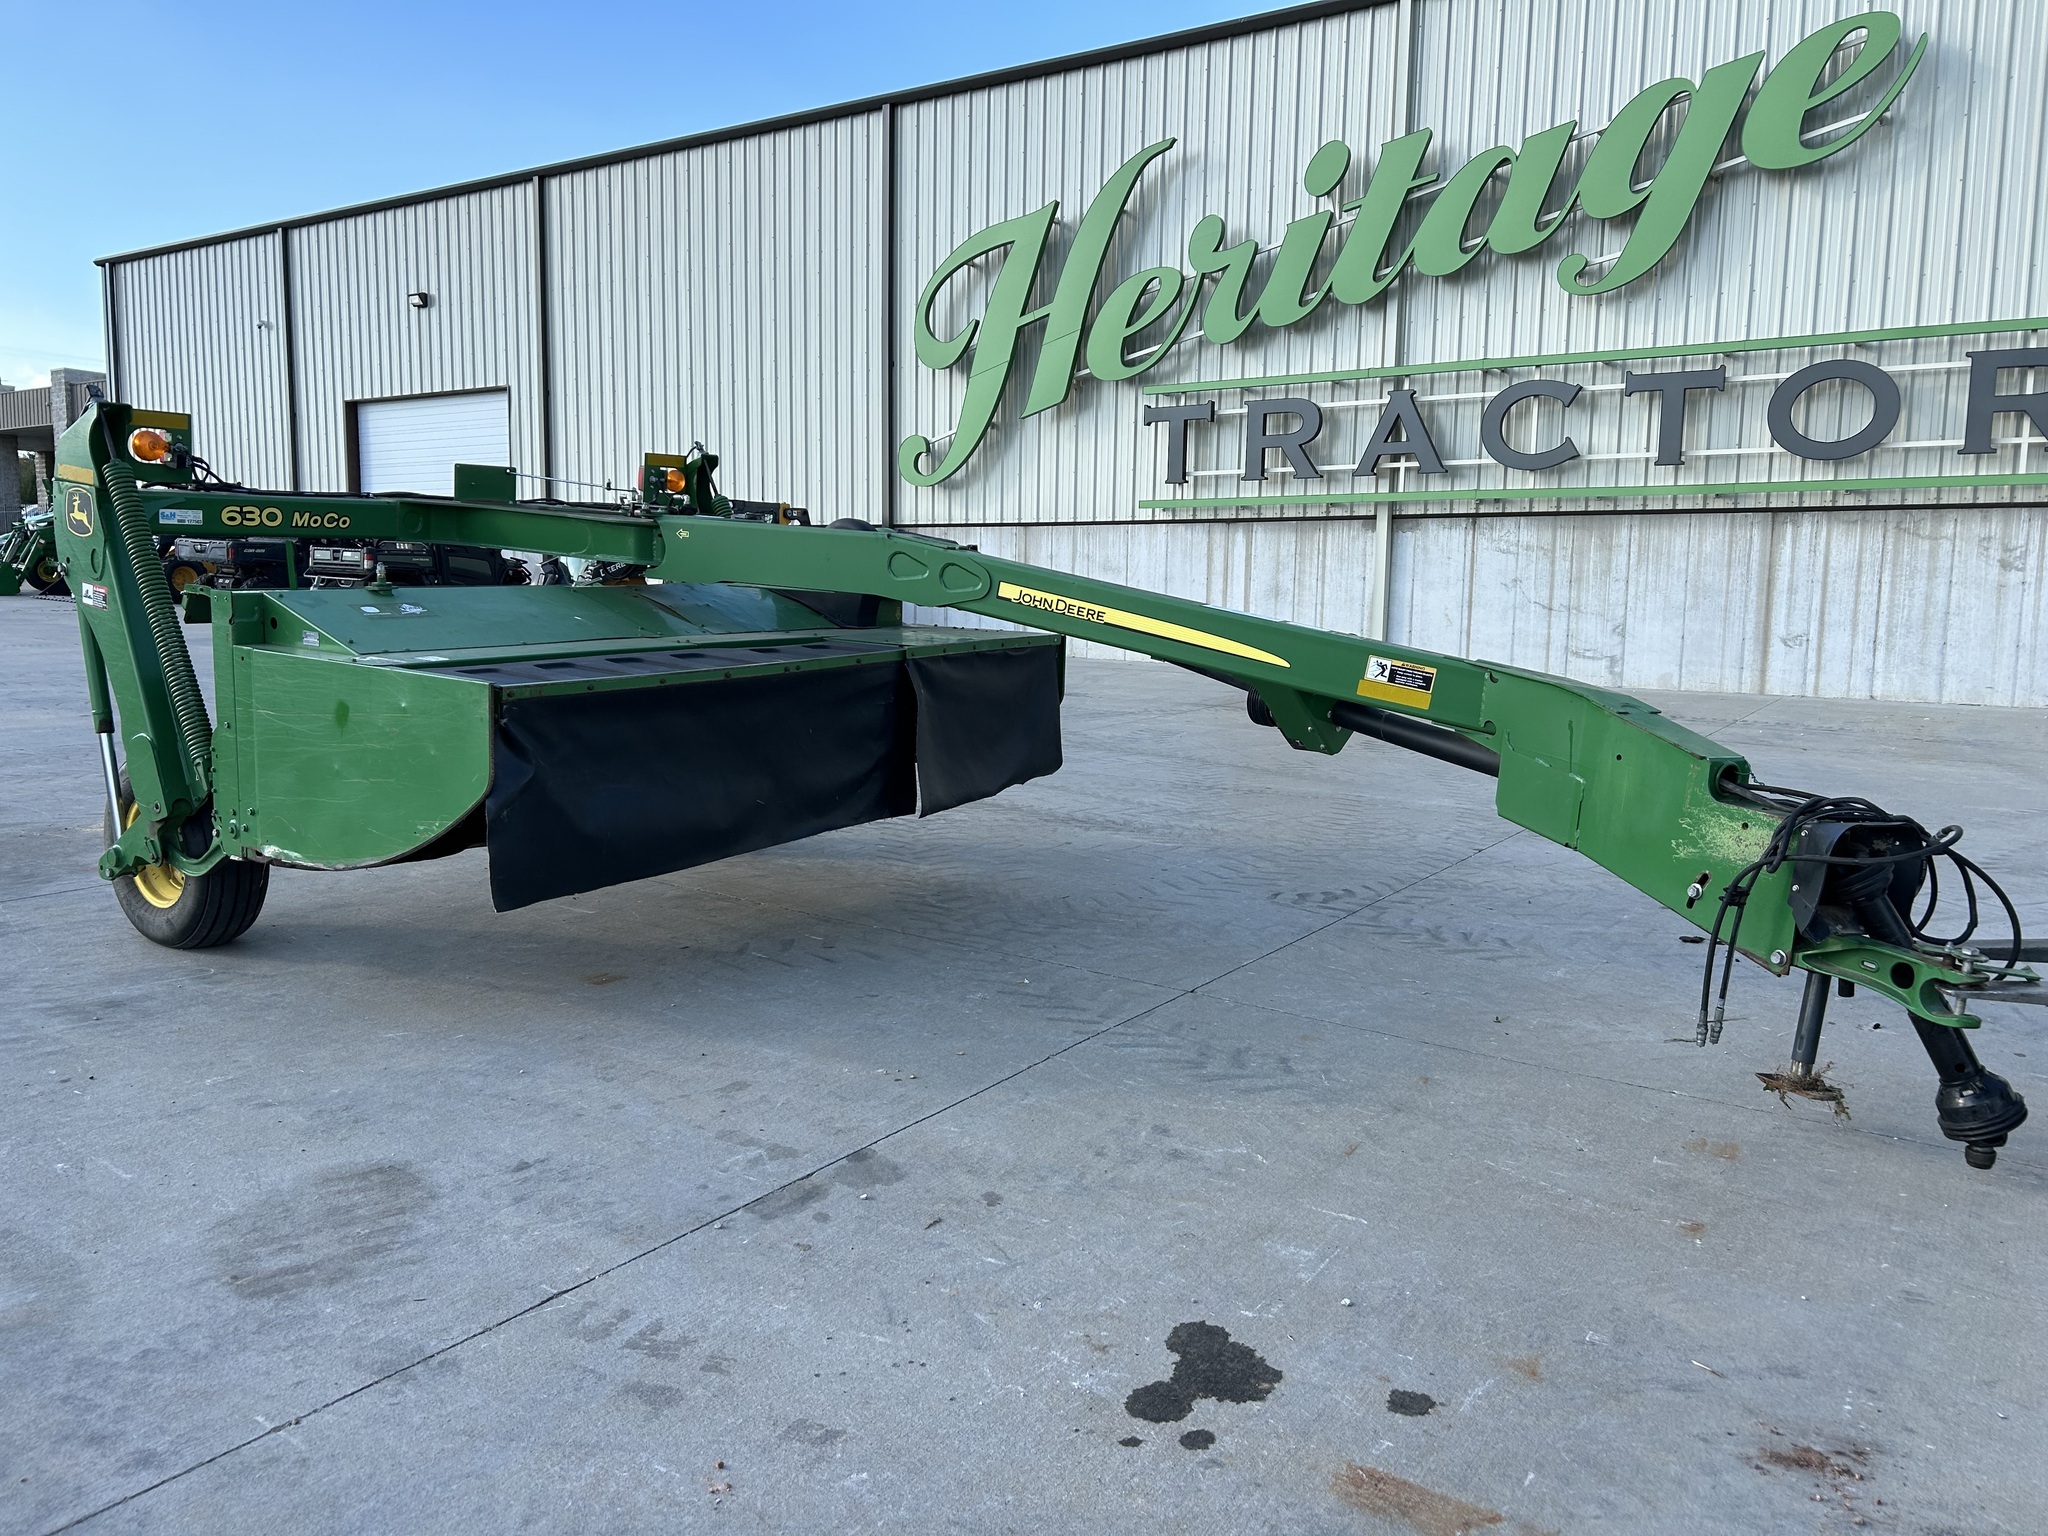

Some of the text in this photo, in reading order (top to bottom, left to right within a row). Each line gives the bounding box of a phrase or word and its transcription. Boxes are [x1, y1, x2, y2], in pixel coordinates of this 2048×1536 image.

[898, 10, 1929, 487] Heritage
[1143, 347, 2048, 484] TRACTOR
[220, 505, 283, 527] 630
[291, 511, 351, 529] MoCo
[1013, 589, 1106, 622] JOHN DEERE
